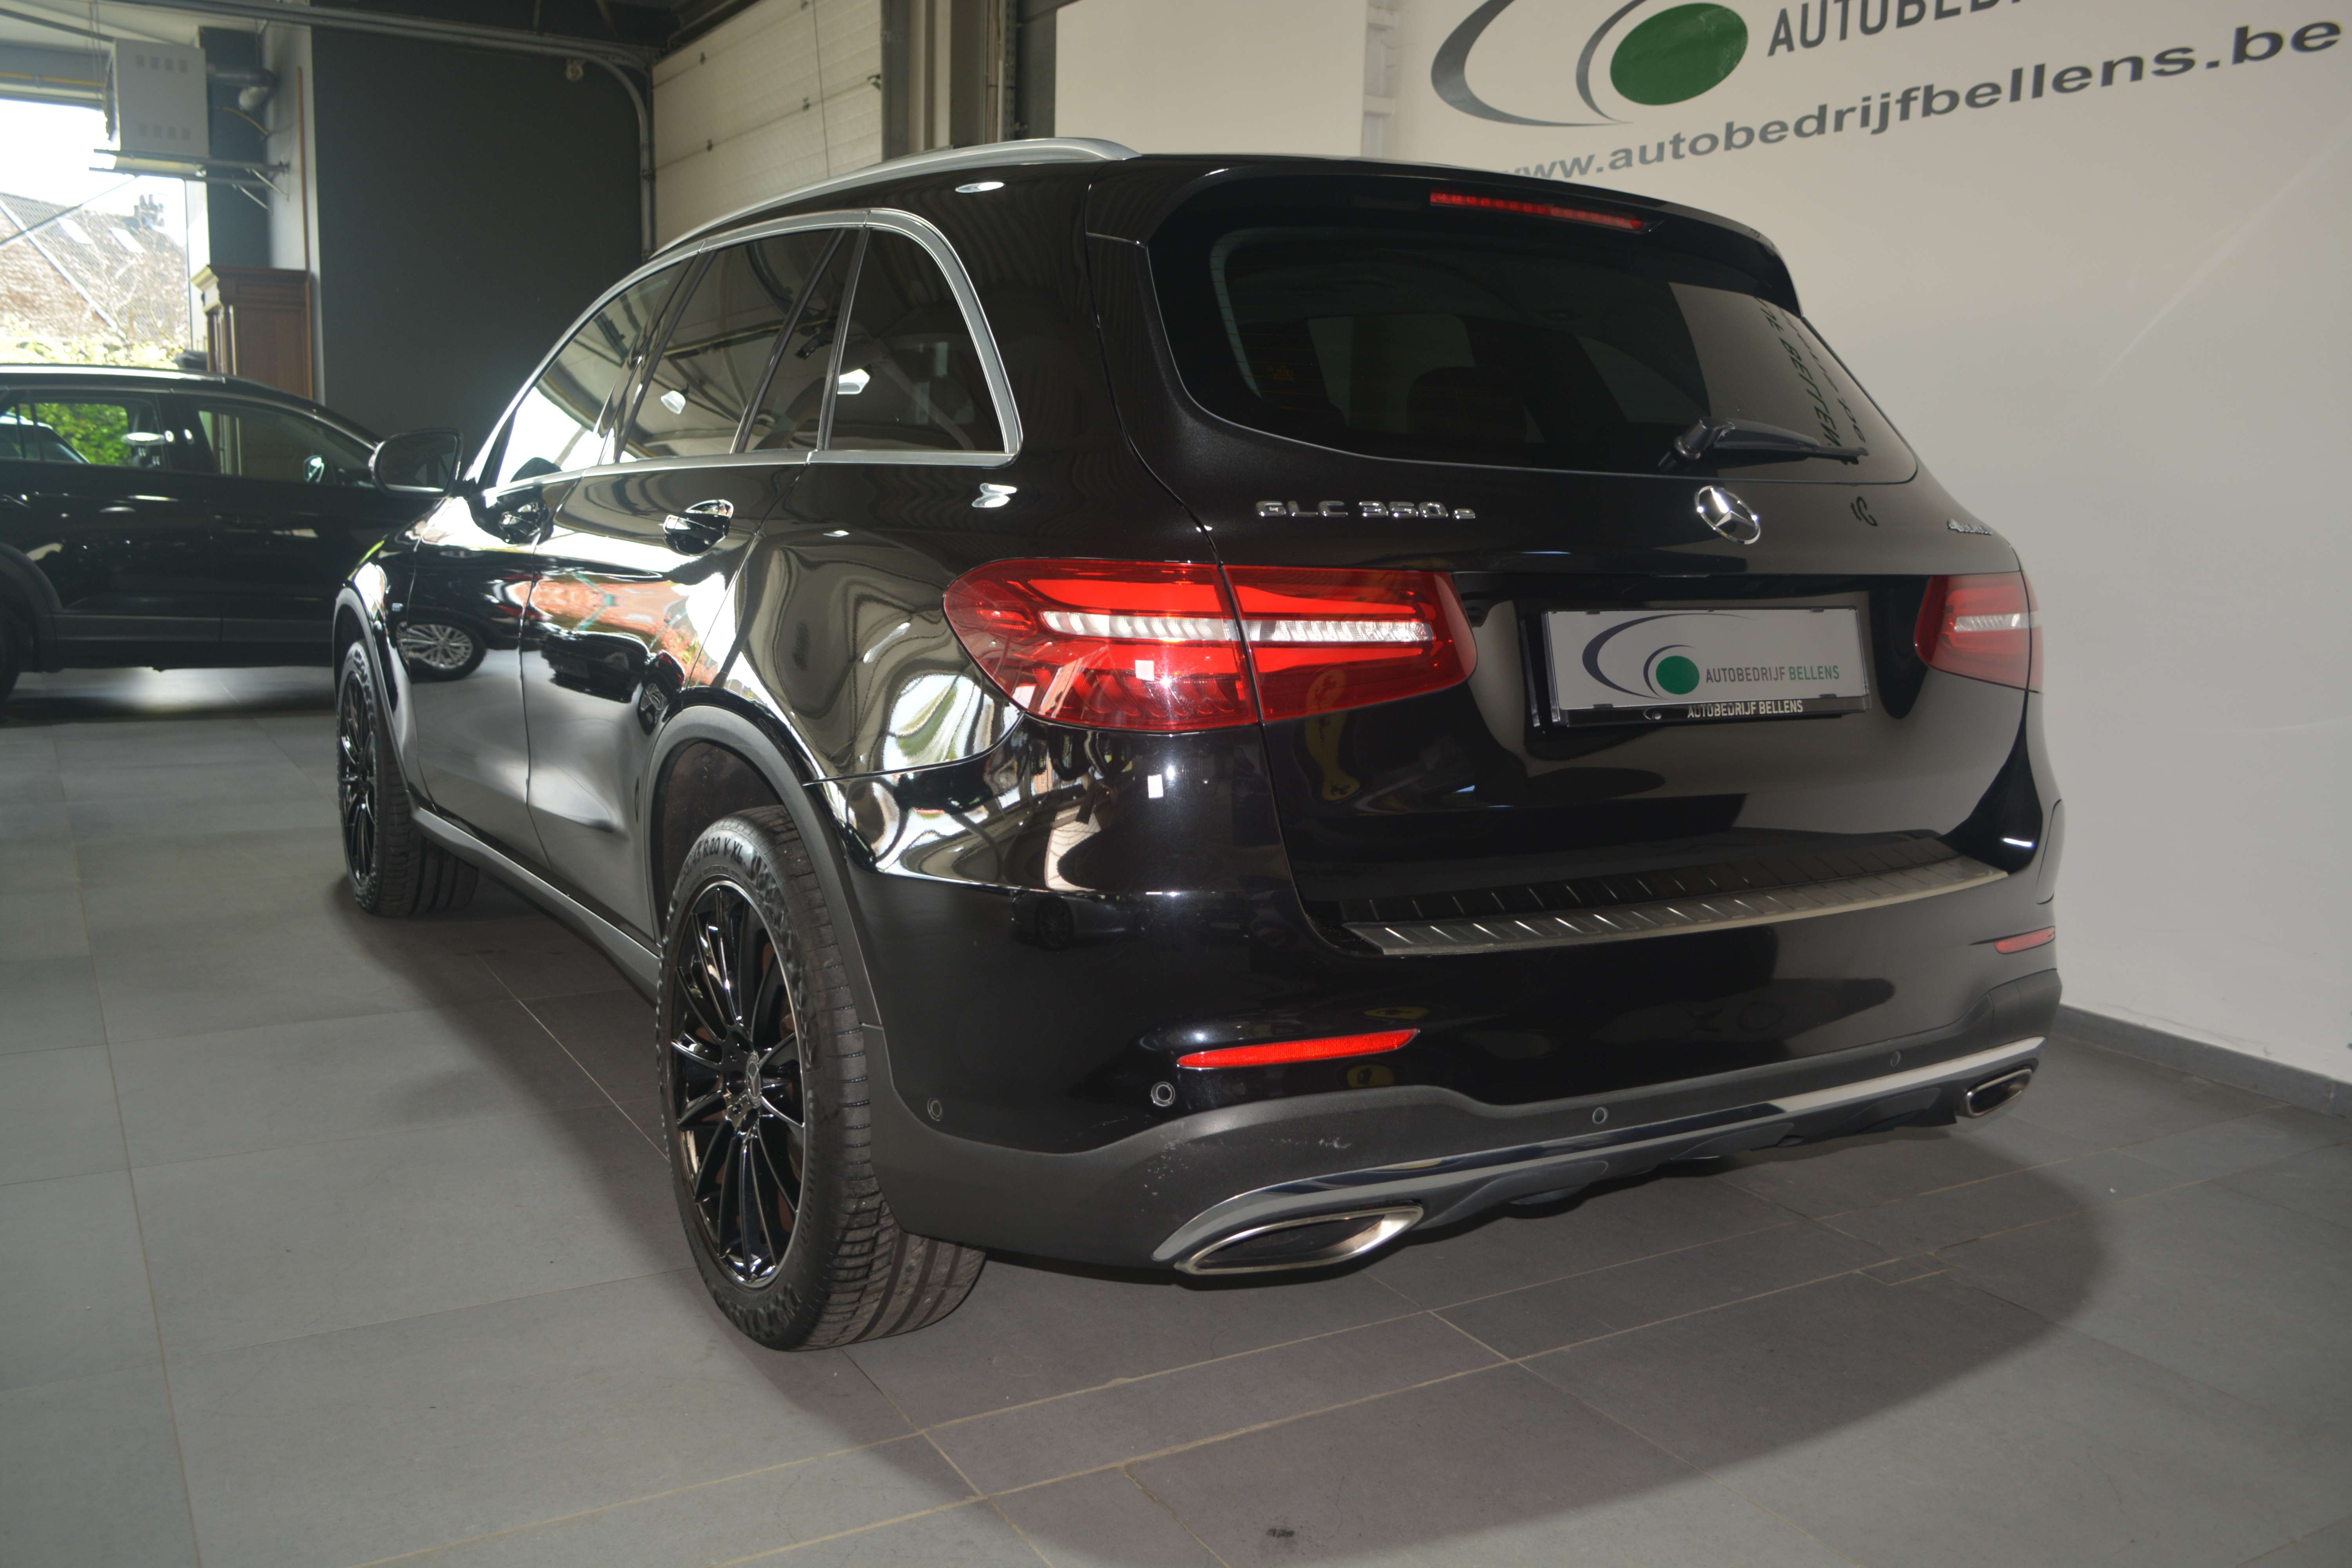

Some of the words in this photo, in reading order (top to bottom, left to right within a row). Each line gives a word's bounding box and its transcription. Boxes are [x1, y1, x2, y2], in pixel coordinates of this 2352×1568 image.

[1767, 0, 2021, 57] AUTOB
[1508, 22, 2341, 179] ww.autobedrijfbellens.be
[1256, 500, 1348, 518] GLC
[1706, 666, 1785, 683] AUTOBEDRIJF
[1788, 665, 1840, 681] BELLENS
[1687, 702, 1757, 718] AUTOBEDRIJF
[1759, 700, 1804, 715] BELLENS
